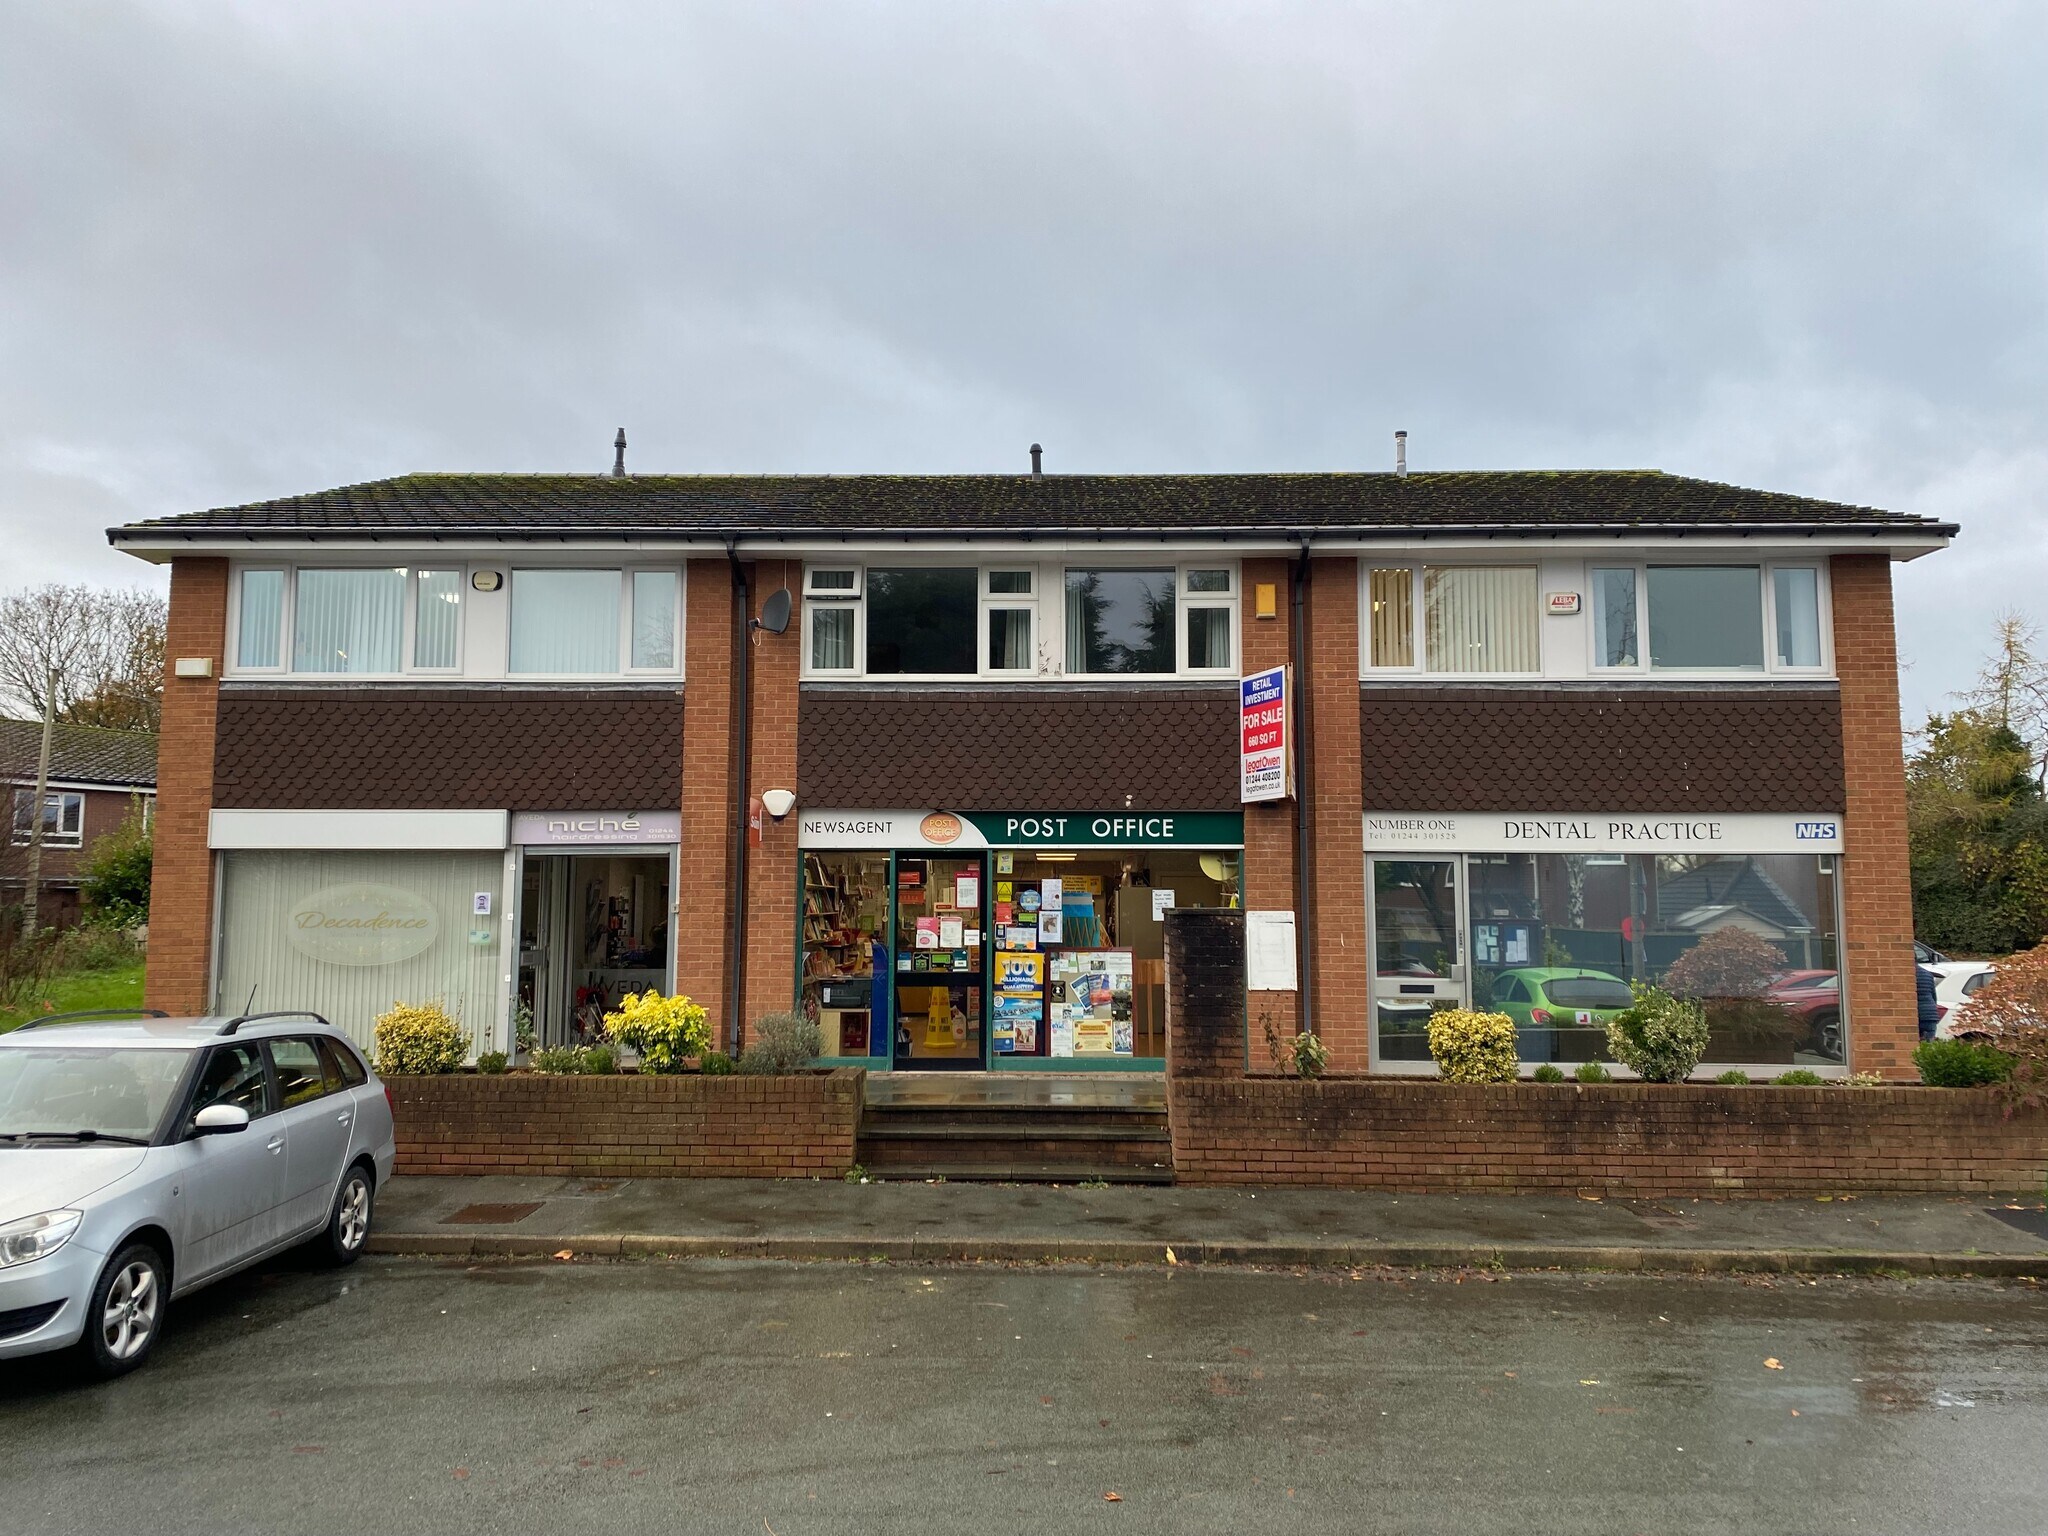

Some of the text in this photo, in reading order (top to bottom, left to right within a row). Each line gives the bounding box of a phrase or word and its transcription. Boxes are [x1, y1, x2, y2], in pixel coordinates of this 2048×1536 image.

[1252, 677, 1272, 691] RETAIL
[1245, 687, 1280, 705] INVESTMENT
[1243, 707, 1283, 730] FOR SALE
[1259, 733, 1268, 745] SQ
[1269, 731, 1277, 743] FT
[1245, 774, 1261, 785] 01244
[1245, 781, 1281, 794] legatowen.co.uk
[804, 821, 893, 834] NEWSAGENT
[929, 819, 953, 827] POST
[1007, 818, 1174, 837] POST OFFICE
[1369, 819, 1456, 830] NUMBER ONE
[552, 833, 638, 841] hairdressing
[925, 828, 956, 837] OFFICE
[1369, 832, 1457, 840] Tel: 01244 301528
[1503, 821, 1722, 840] DENTAL PRACTICE
[1797, 823, 1836, 839] NHS
[294, 911, 429, 932] Decadence
[1001, 959, 1038, 977] 100
[599, 980, 657, 994] VEDA
